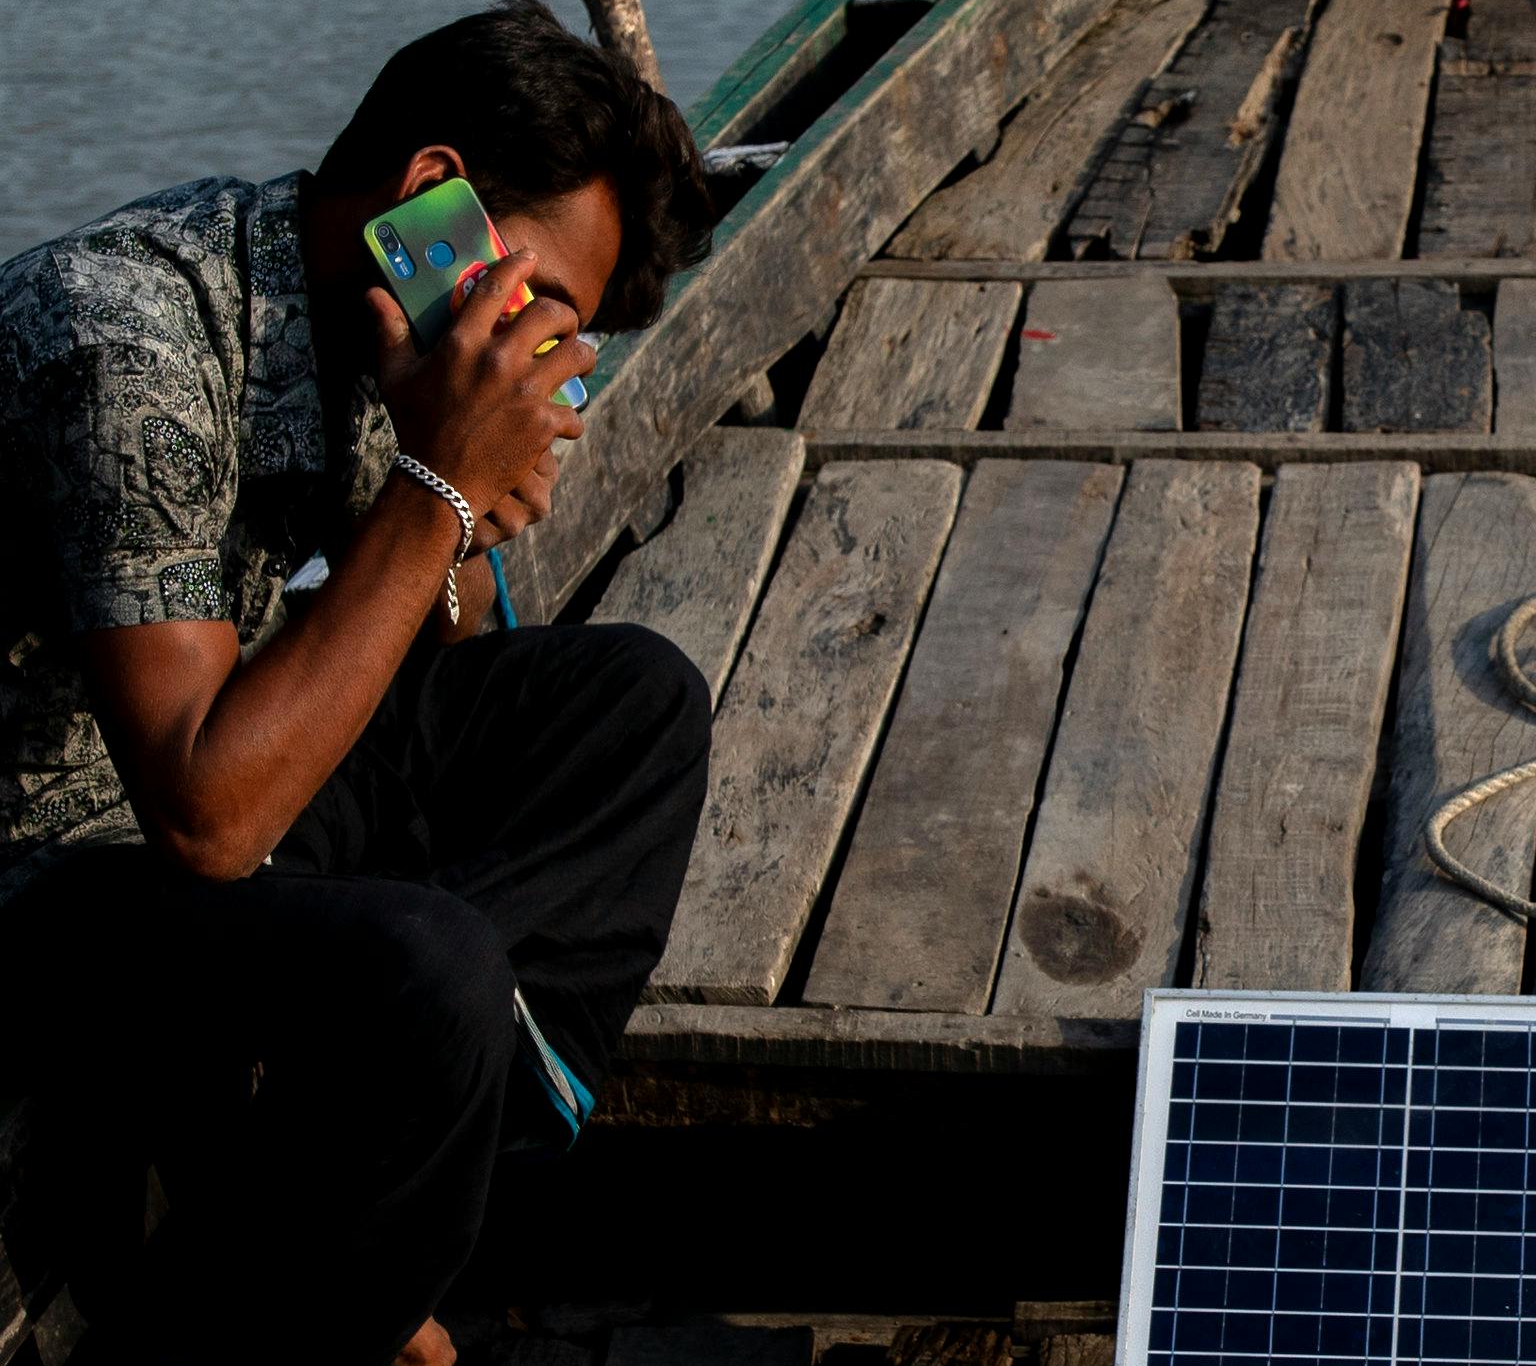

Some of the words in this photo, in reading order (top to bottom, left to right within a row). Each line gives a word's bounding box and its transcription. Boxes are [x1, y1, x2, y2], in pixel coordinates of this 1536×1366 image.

[1186, 1009, 1200, 1017] Cell
[1202, 1010, 1222, 1018] Made
[1233, 1011, 1267, 1021] Germany
